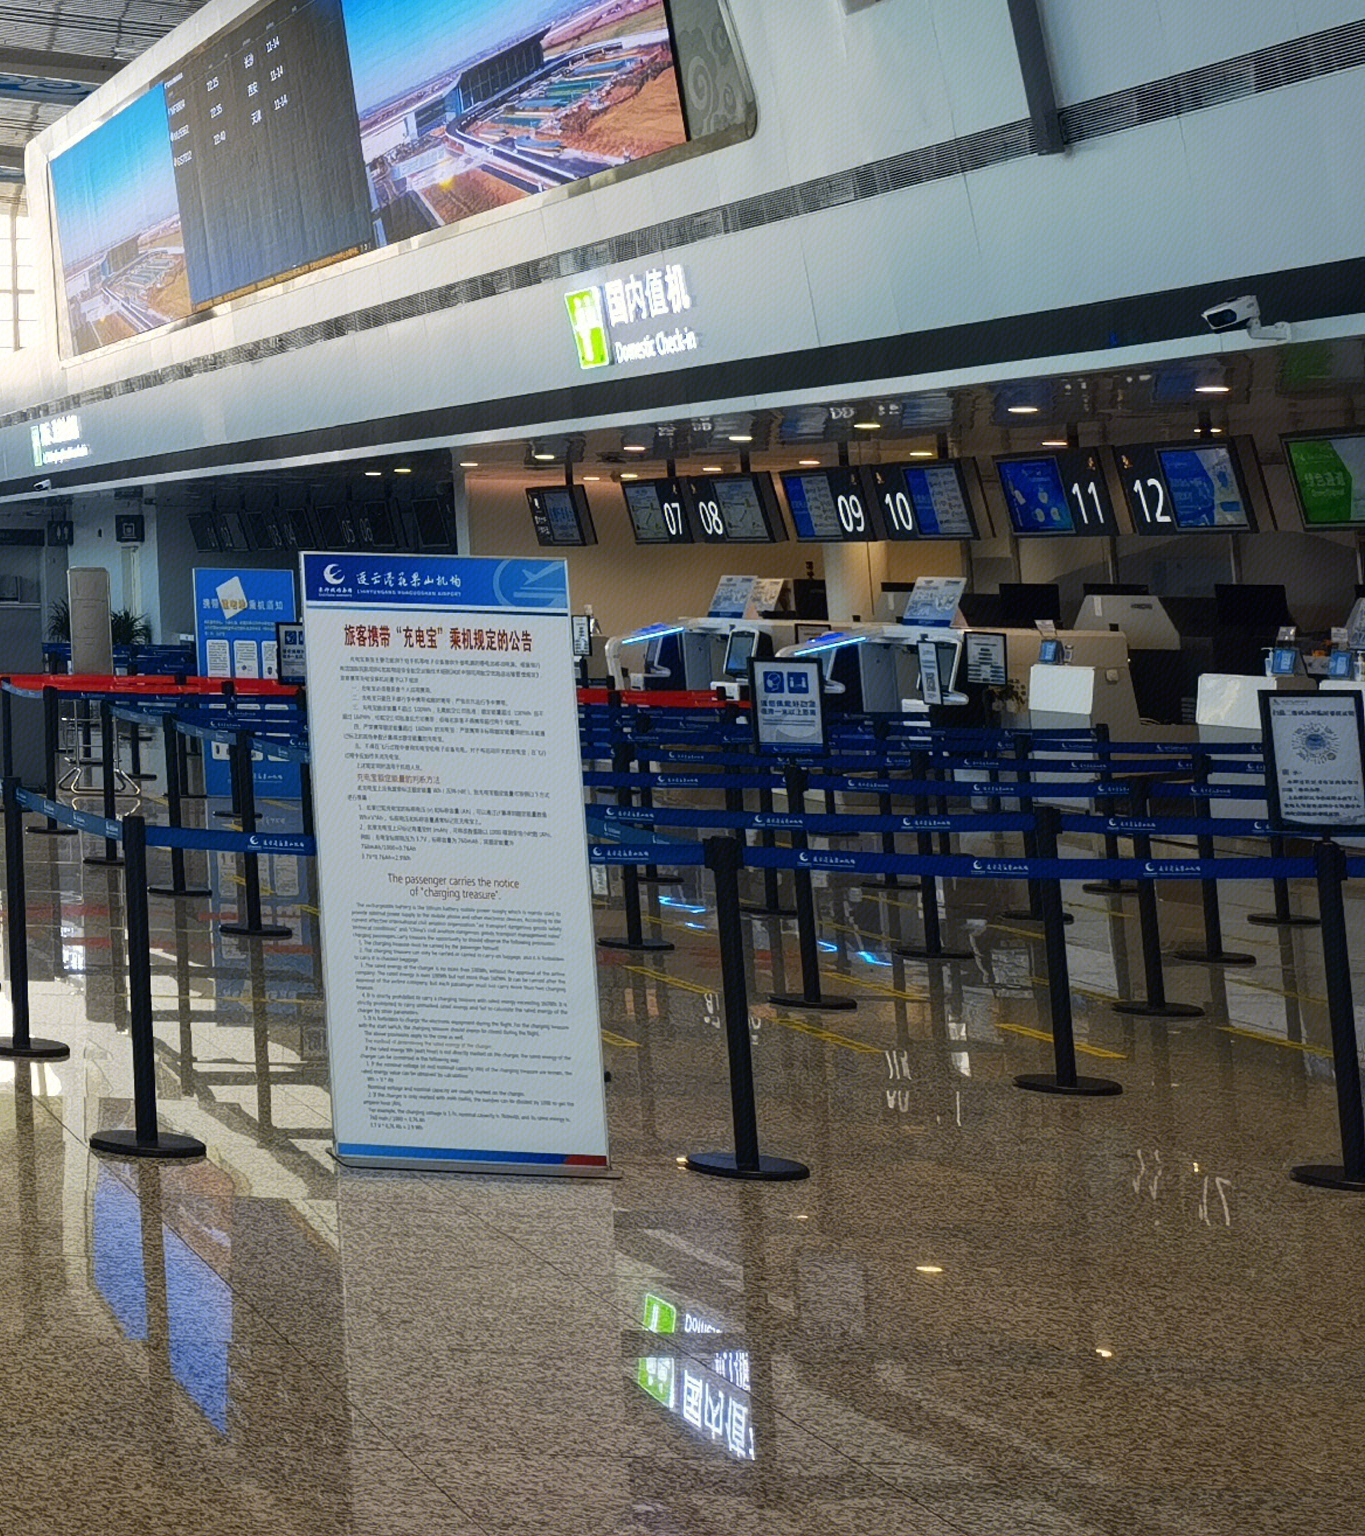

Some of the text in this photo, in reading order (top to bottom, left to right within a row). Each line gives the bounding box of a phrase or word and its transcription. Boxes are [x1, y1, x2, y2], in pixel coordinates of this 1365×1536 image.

[605, 264, 692, 327] 国内值机
[615, 327, 697, 363] Domestic Check-in
[663, 502, 683, 535] 07
[698, 501, 723, 535] 08
[837, 494, 865, 532] 09
[884, 492, 913, 531] 10
[1072, 481, 1104, 524] 11
[1133, 478, 1172, 523] 12
[388, 873, 520, 889] The passenger carries the notice
[409, 887, 418, 897] of
